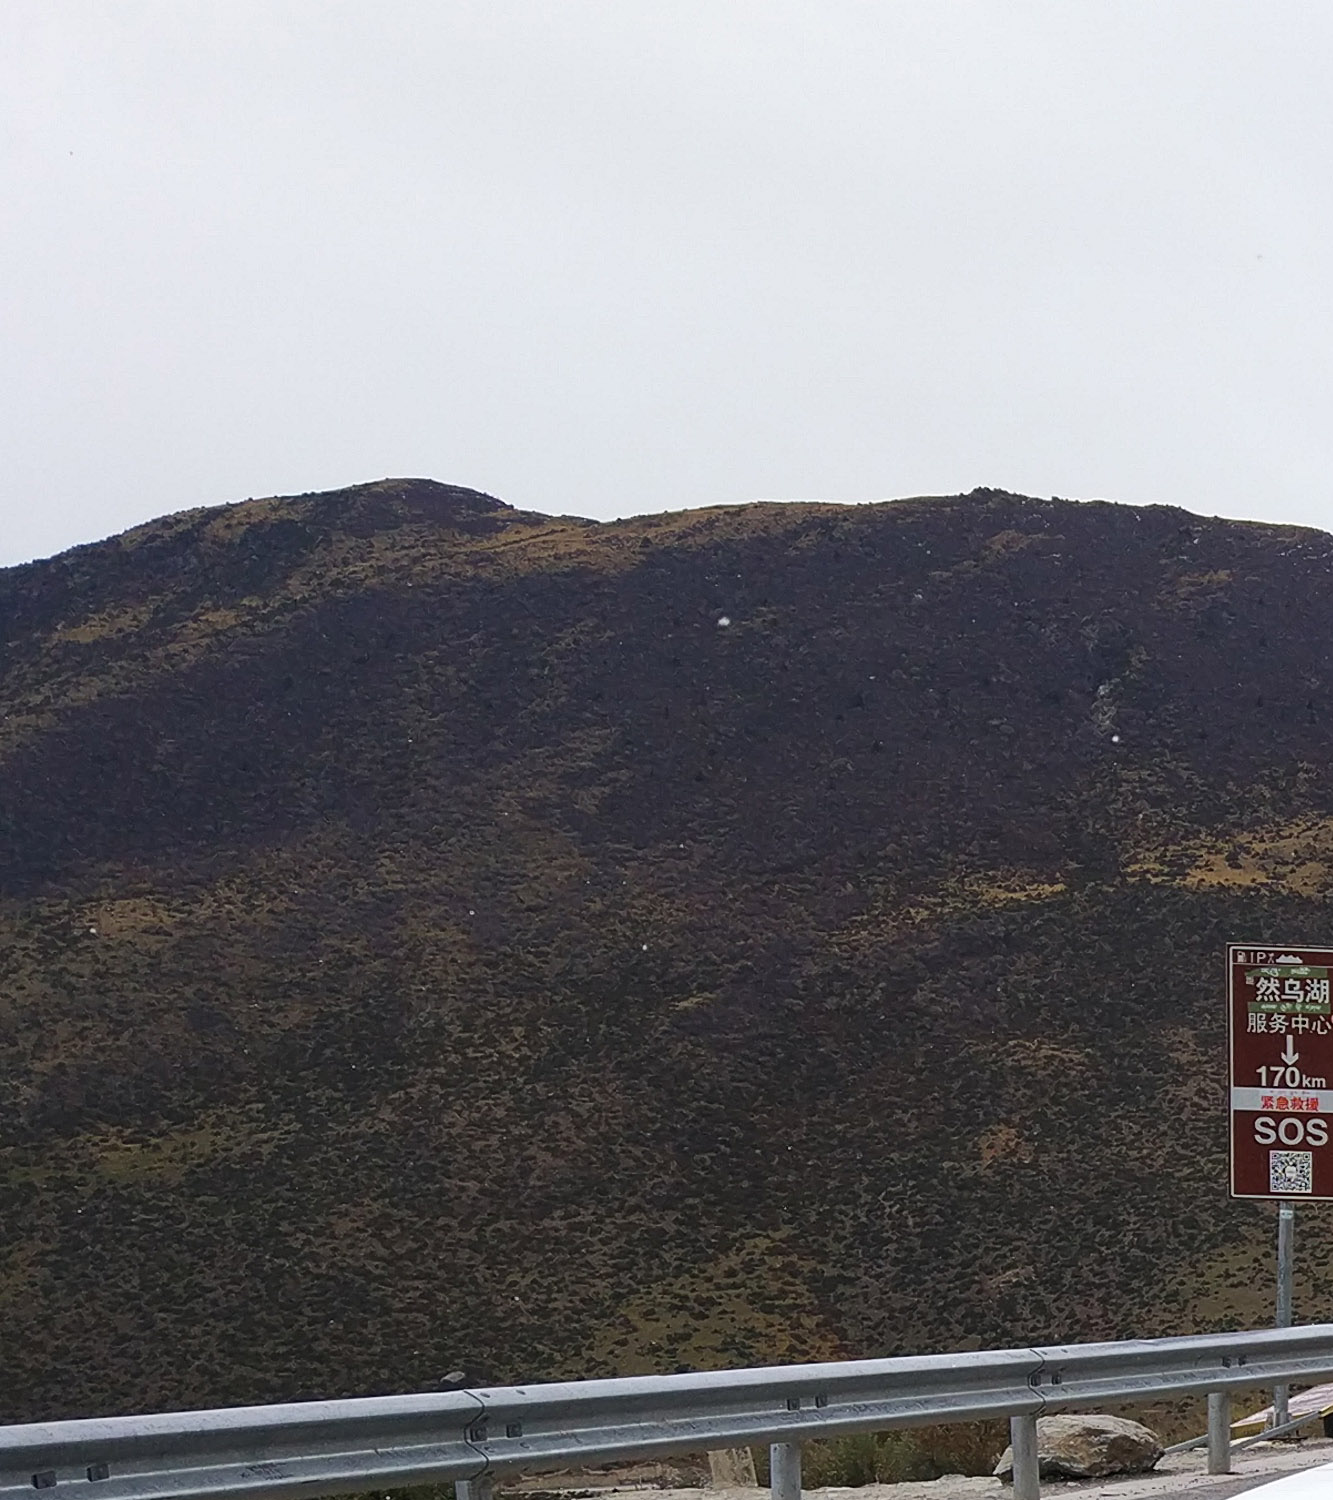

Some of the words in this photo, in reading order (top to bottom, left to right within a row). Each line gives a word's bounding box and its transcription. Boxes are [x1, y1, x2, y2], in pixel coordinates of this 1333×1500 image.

[1256, 977, 1330, 1004] 然乌湖
[1247, 1012, 1332, 1035] 服务中心
[1261, 1095, 1319, 1111] 紧急救援
[1254, 1116, 1329, 1147] SOS
